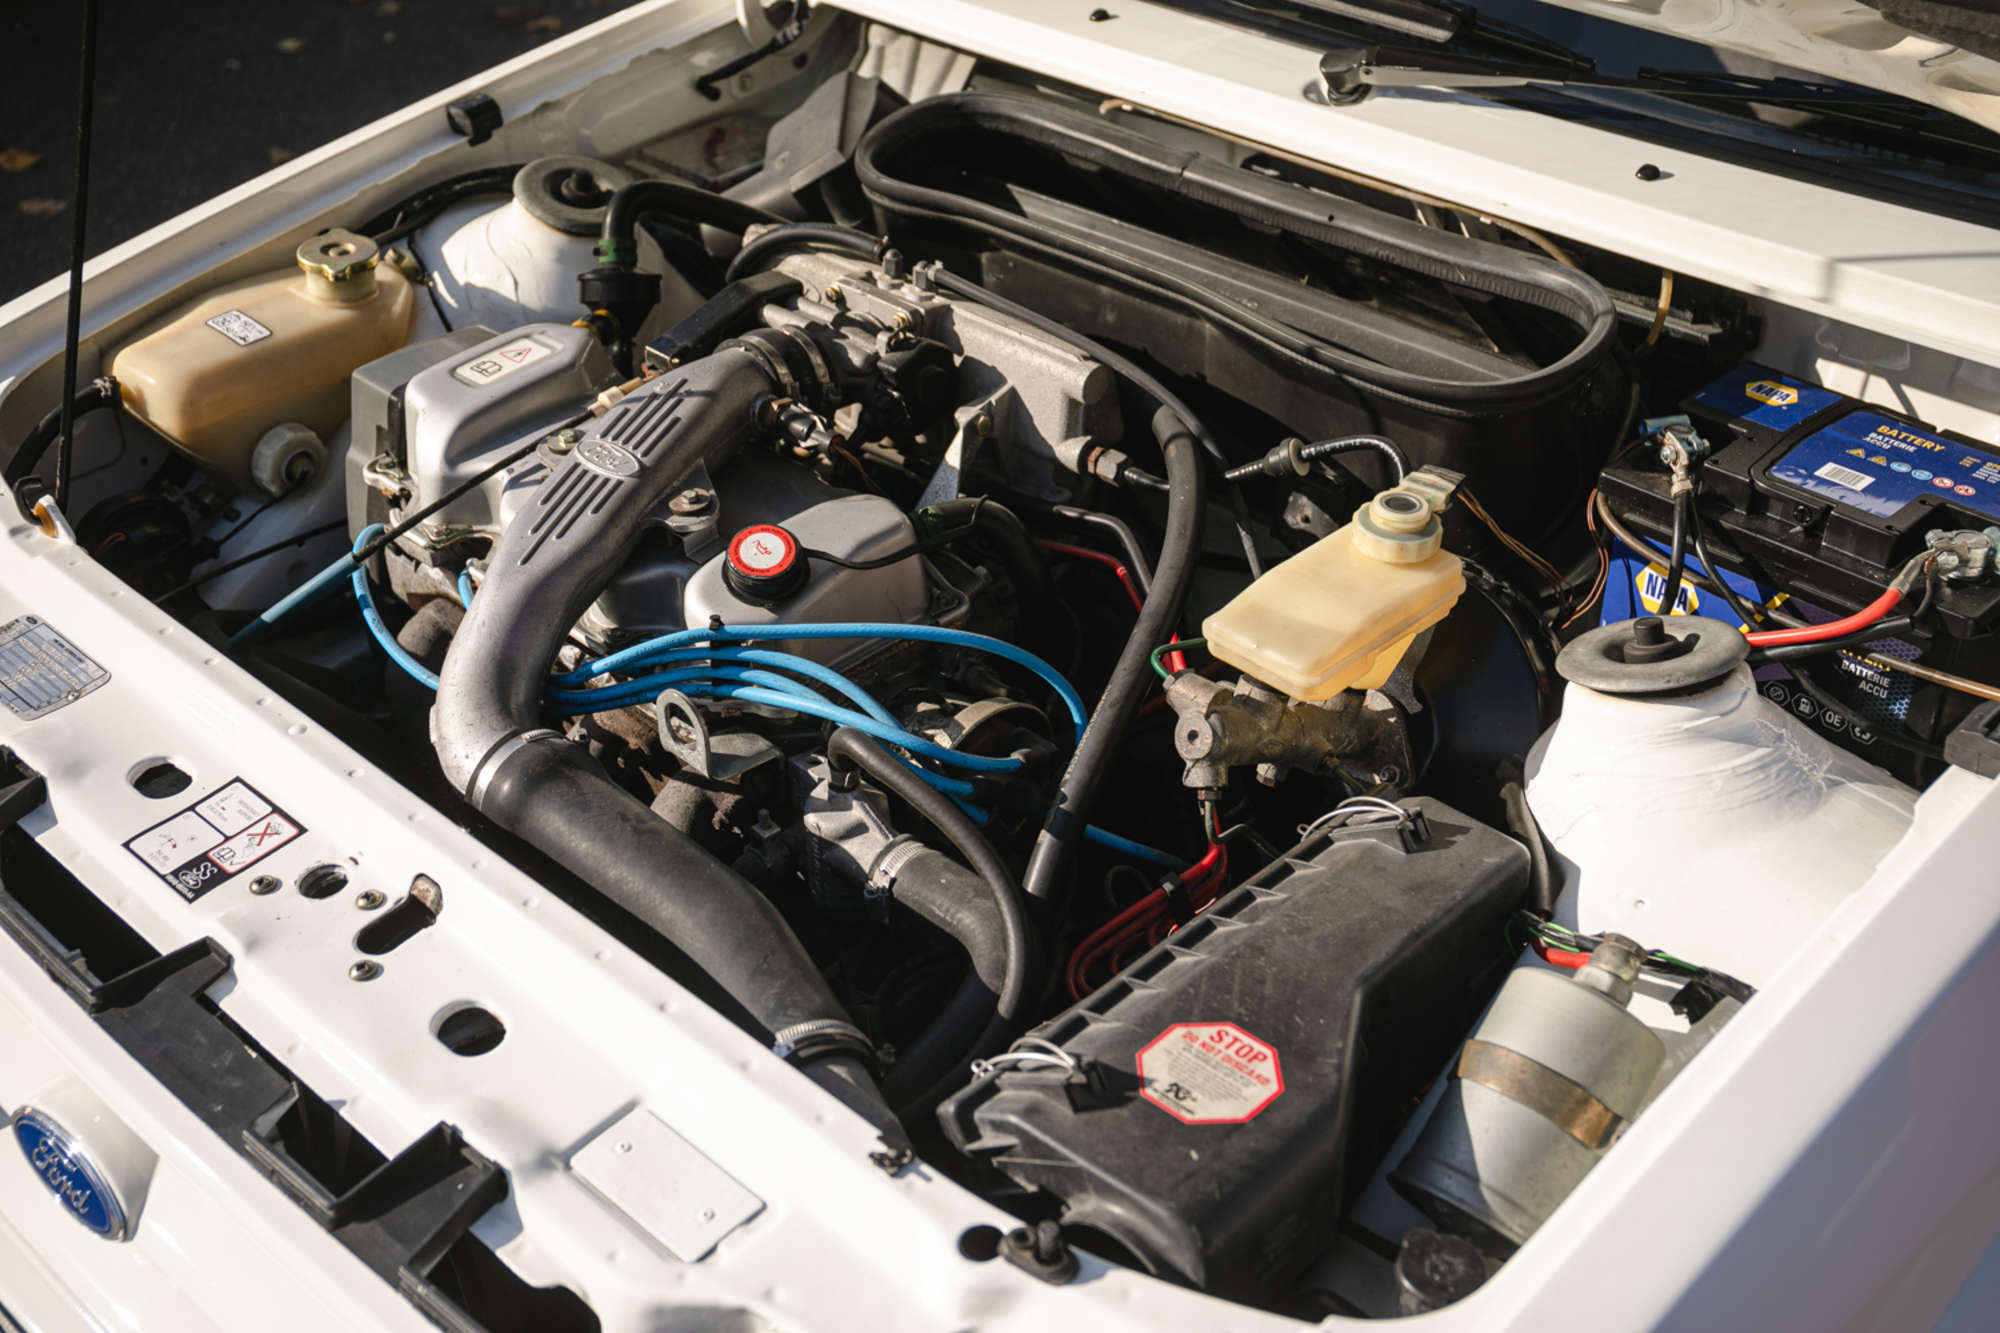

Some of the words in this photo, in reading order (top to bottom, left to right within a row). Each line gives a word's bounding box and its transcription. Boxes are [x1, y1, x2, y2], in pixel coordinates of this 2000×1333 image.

[1750, 382, 1792, 402] NAPA
[1863, 437, 1892, 450] ACCU
[1868, 432, 1918, 453] BATTERIE
[1876, 424, 1946, 453] BATTERY
[1841, 659, 1890, 688] BATTERIE
[1858, 680, 1888, 699] ACCU
[1825, 711, 1842, 727] OE
[1181, 1030, 1199, 1044] DO
[1200, 1040, 1222, 1057] NOT
[1209, 1028, 1269, 1064] STOP
[31, 1135, 92, 1215] Ford
